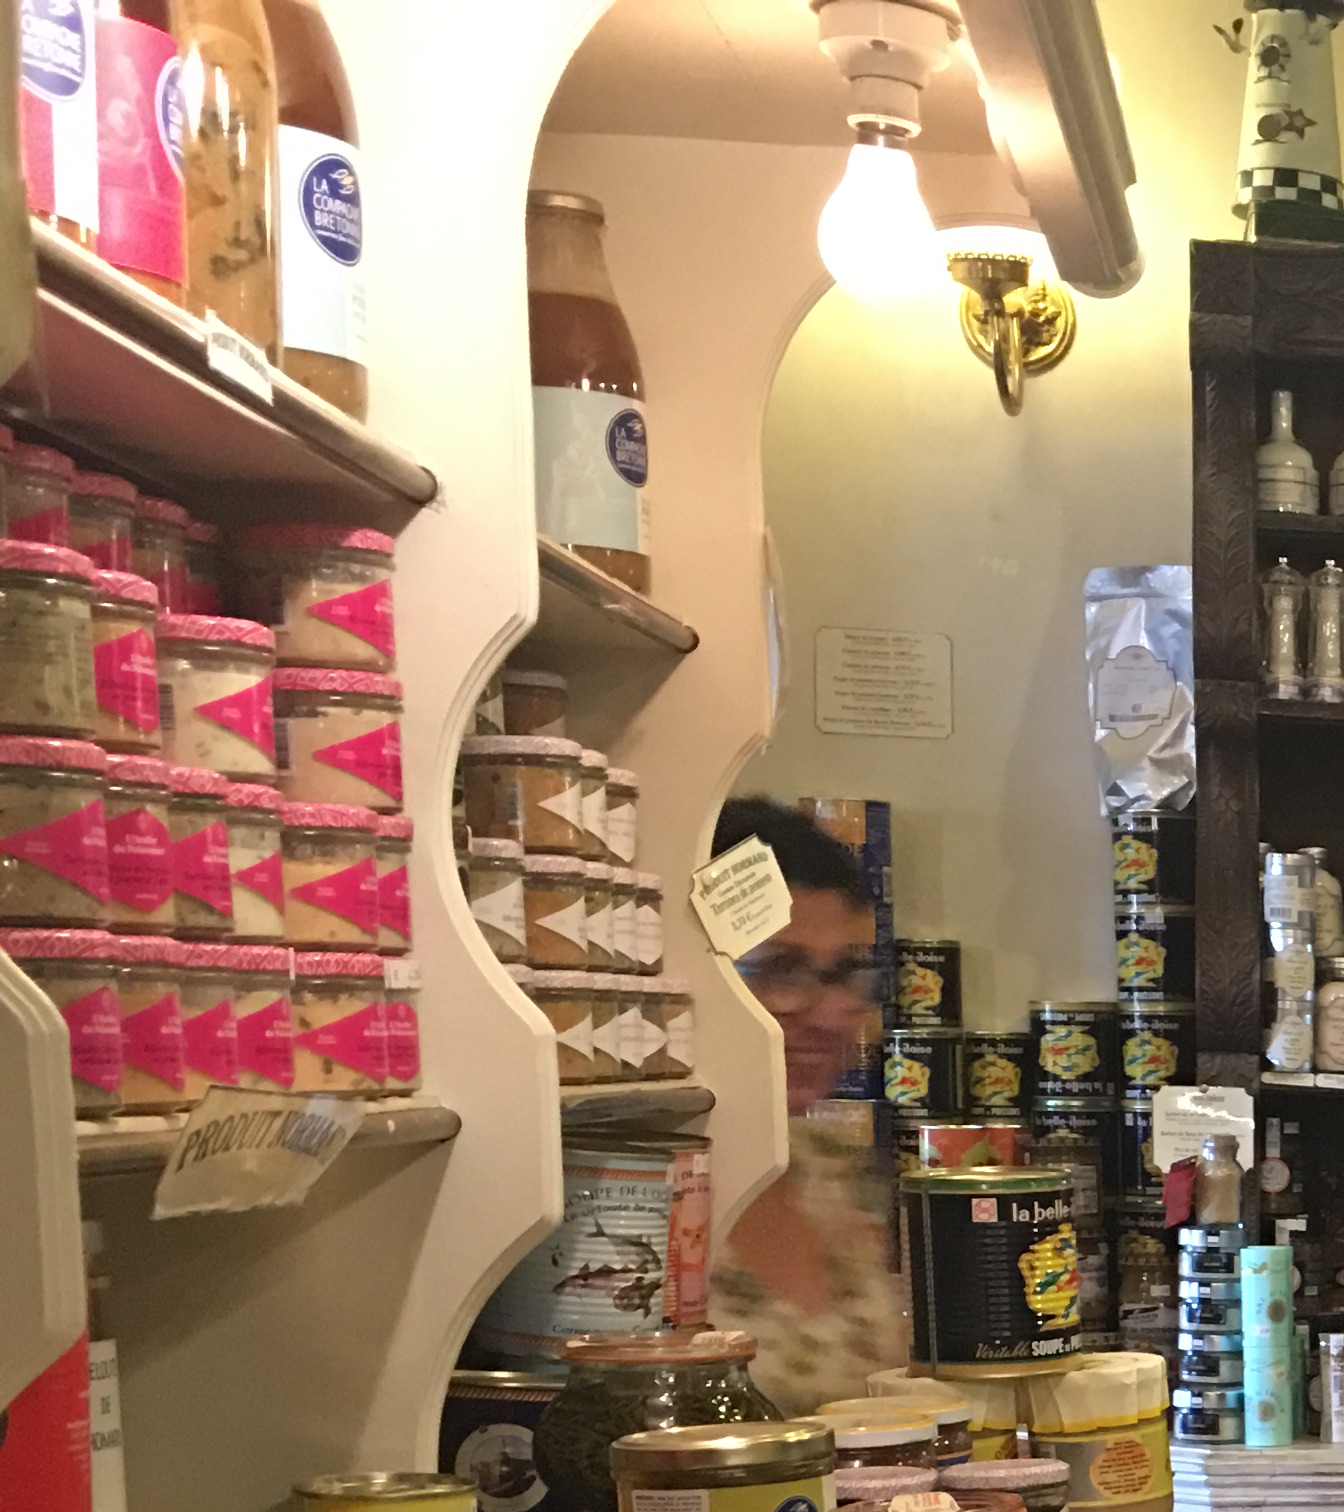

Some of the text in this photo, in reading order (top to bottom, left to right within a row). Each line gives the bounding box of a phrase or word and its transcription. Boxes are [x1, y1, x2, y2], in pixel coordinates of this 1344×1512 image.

[312, 176, 329, 195] LA
[175, 1110, 283, 1174] PRODUIT
[1012, 1201, 1030, 1223] la
[1031, 1337, 1065, 1357] SOUPE
